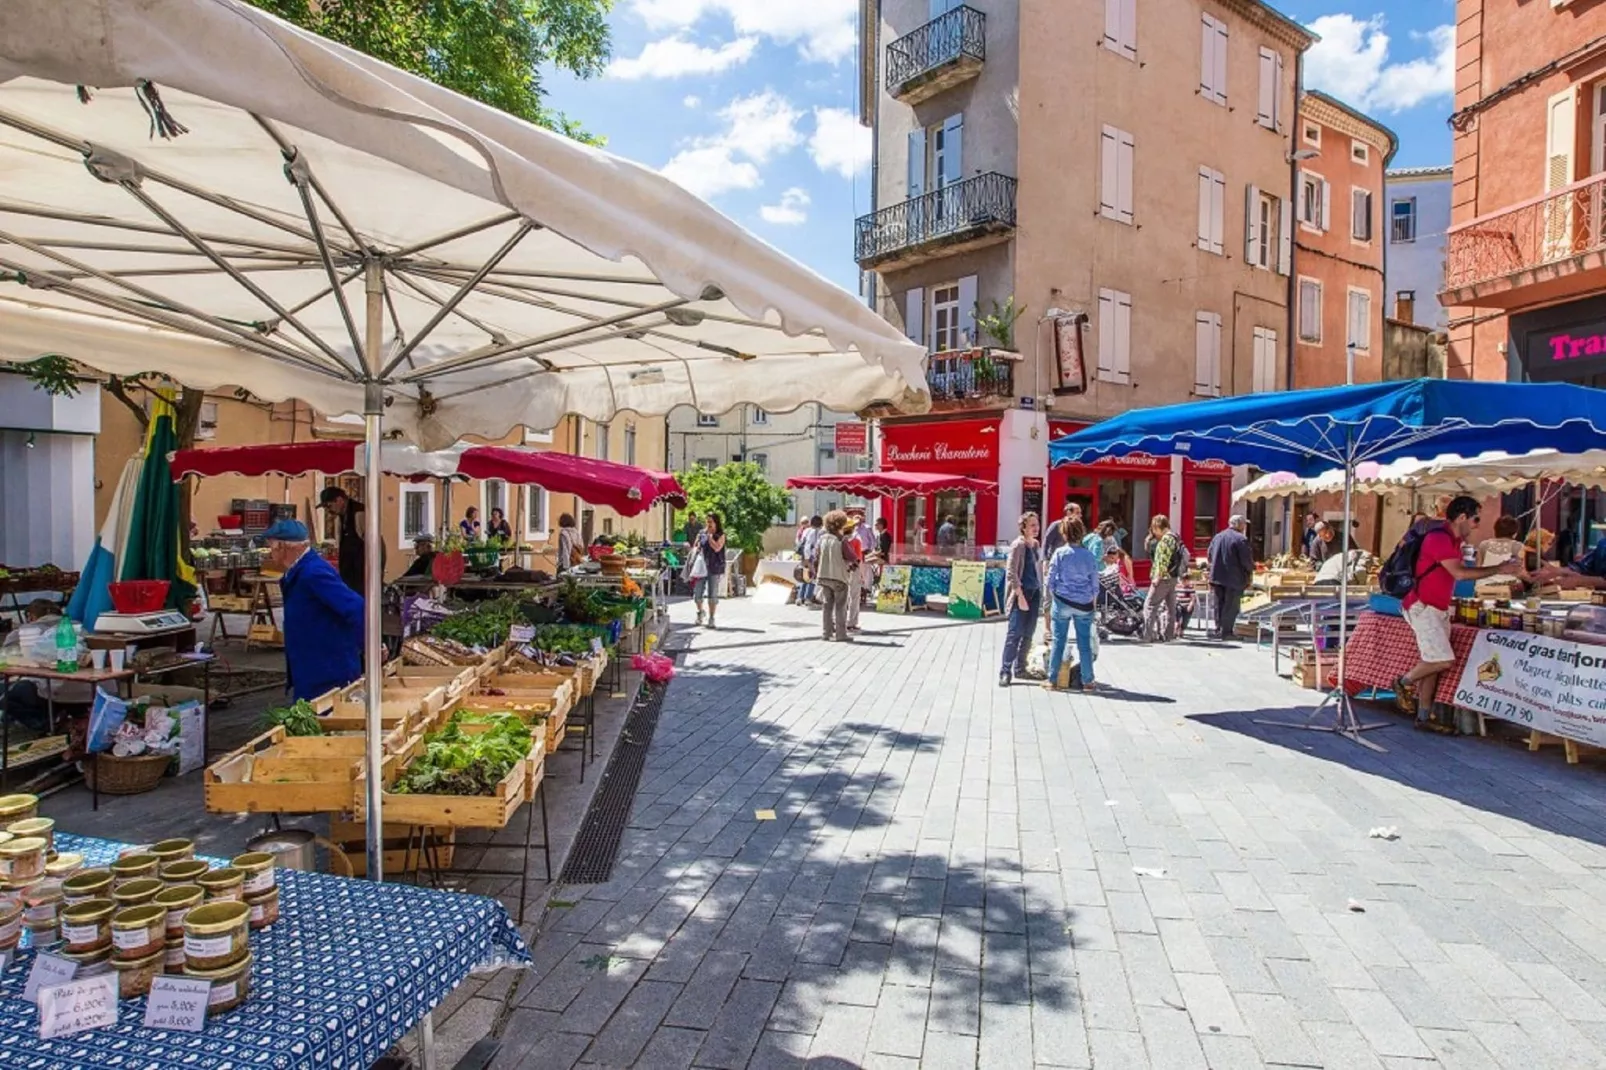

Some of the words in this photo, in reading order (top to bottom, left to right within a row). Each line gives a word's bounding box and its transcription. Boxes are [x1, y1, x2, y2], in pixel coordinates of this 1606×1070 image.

[1549, 333, 1606, 361] Tra
[887, 444, 931, 461] Boucherie
[934, 442, 990, 461] Charcuterie
[1486, 632, 1529, 652] Canard
[1529, 645, 1556, 659] gras
[1457, 689, 1474, 704] 06
[1476, 695, 1490, 709] 21
[1492, 699, 1502, 712] 11
[1504, 703, 1517, 717] 71
